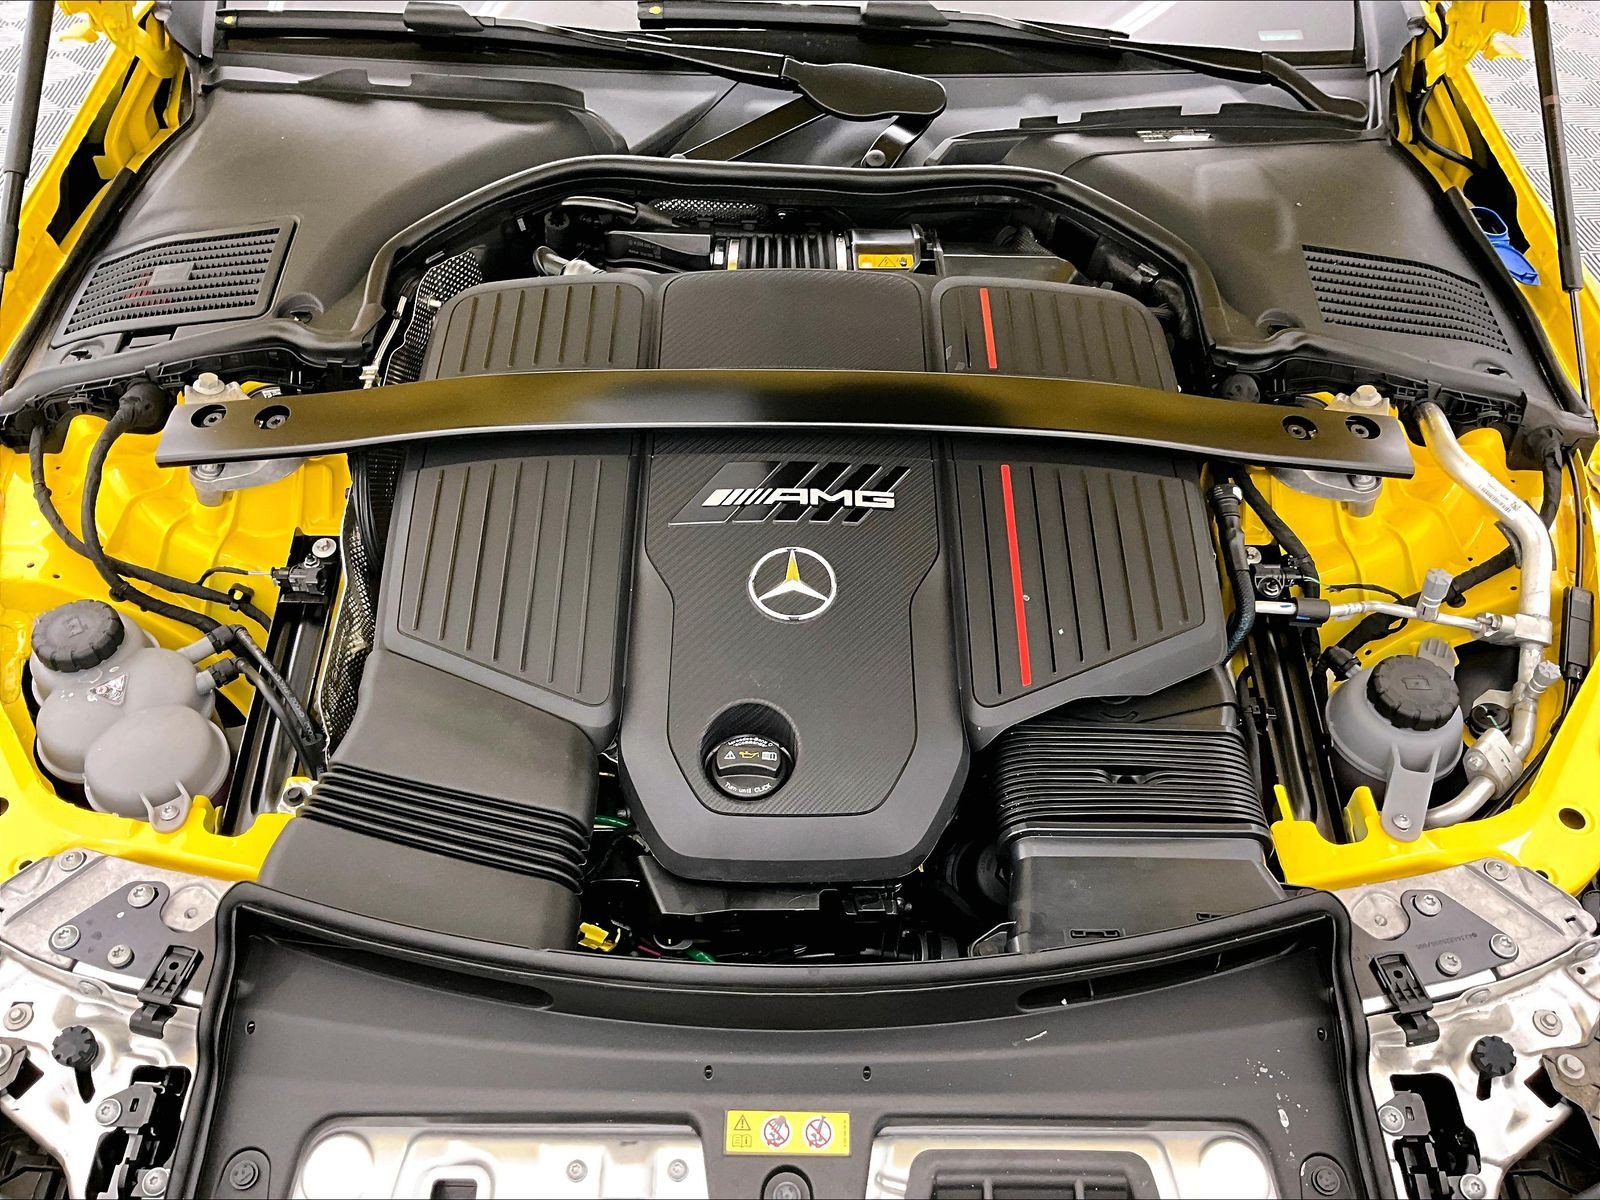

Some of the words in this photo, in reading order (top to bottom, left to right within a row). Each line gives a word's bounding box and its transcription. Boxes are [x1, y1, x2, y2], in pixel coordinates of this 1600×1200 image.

[762, 488, 896, 508] AMG
[725, 782, 737, 792] Turn
[754, 782, 772, 792] CLICK
